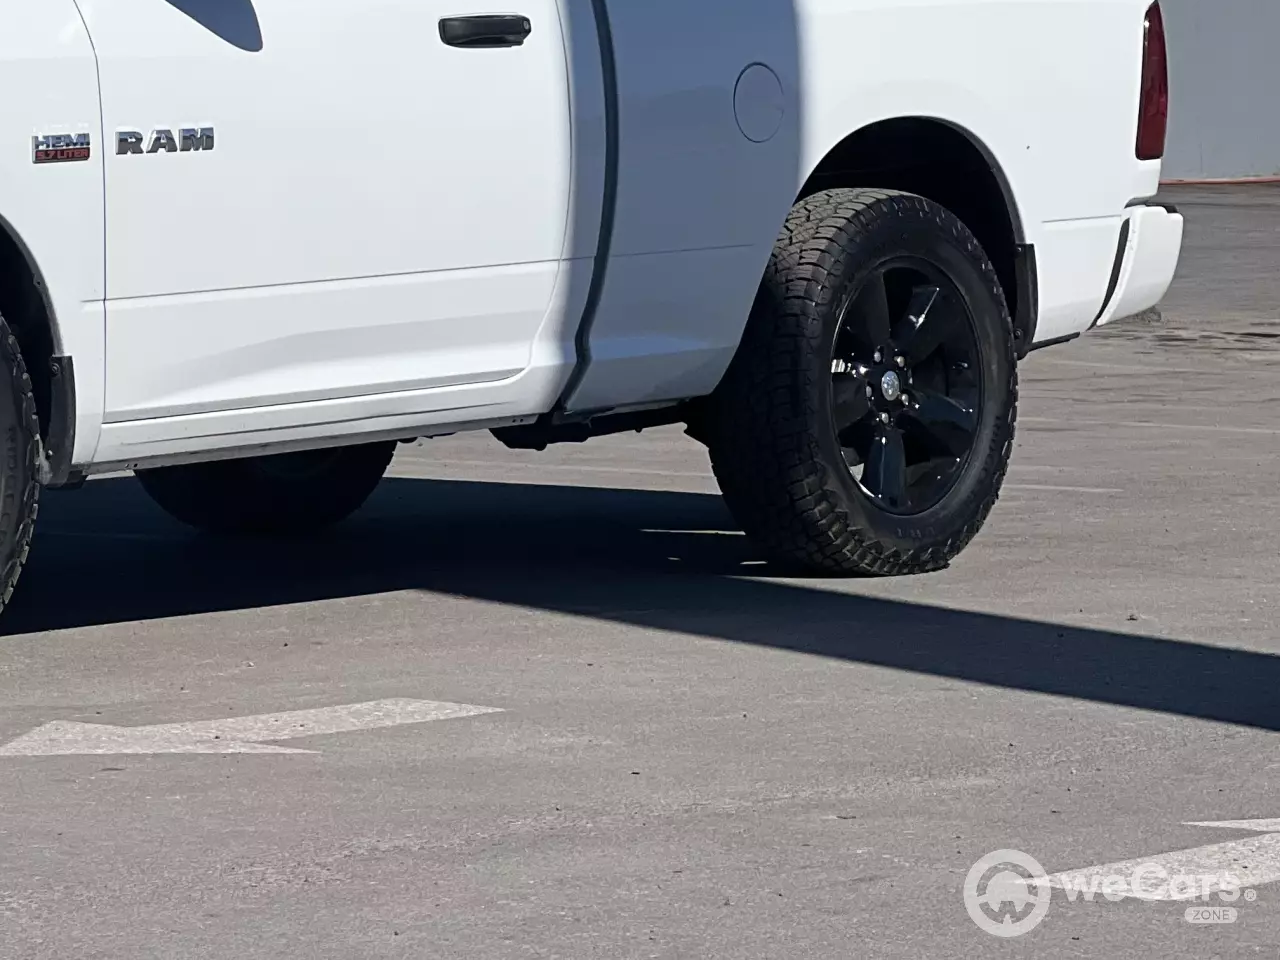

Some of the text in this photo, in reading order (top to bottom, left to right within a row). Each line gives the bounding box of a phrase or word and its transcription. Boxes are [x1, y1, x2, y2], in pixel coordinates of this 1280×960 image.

[31, 133, 90, 149] HEMI
[115, 127, 215, 155] RAM
[37, 149, 89, 160] 5.7 LITER
